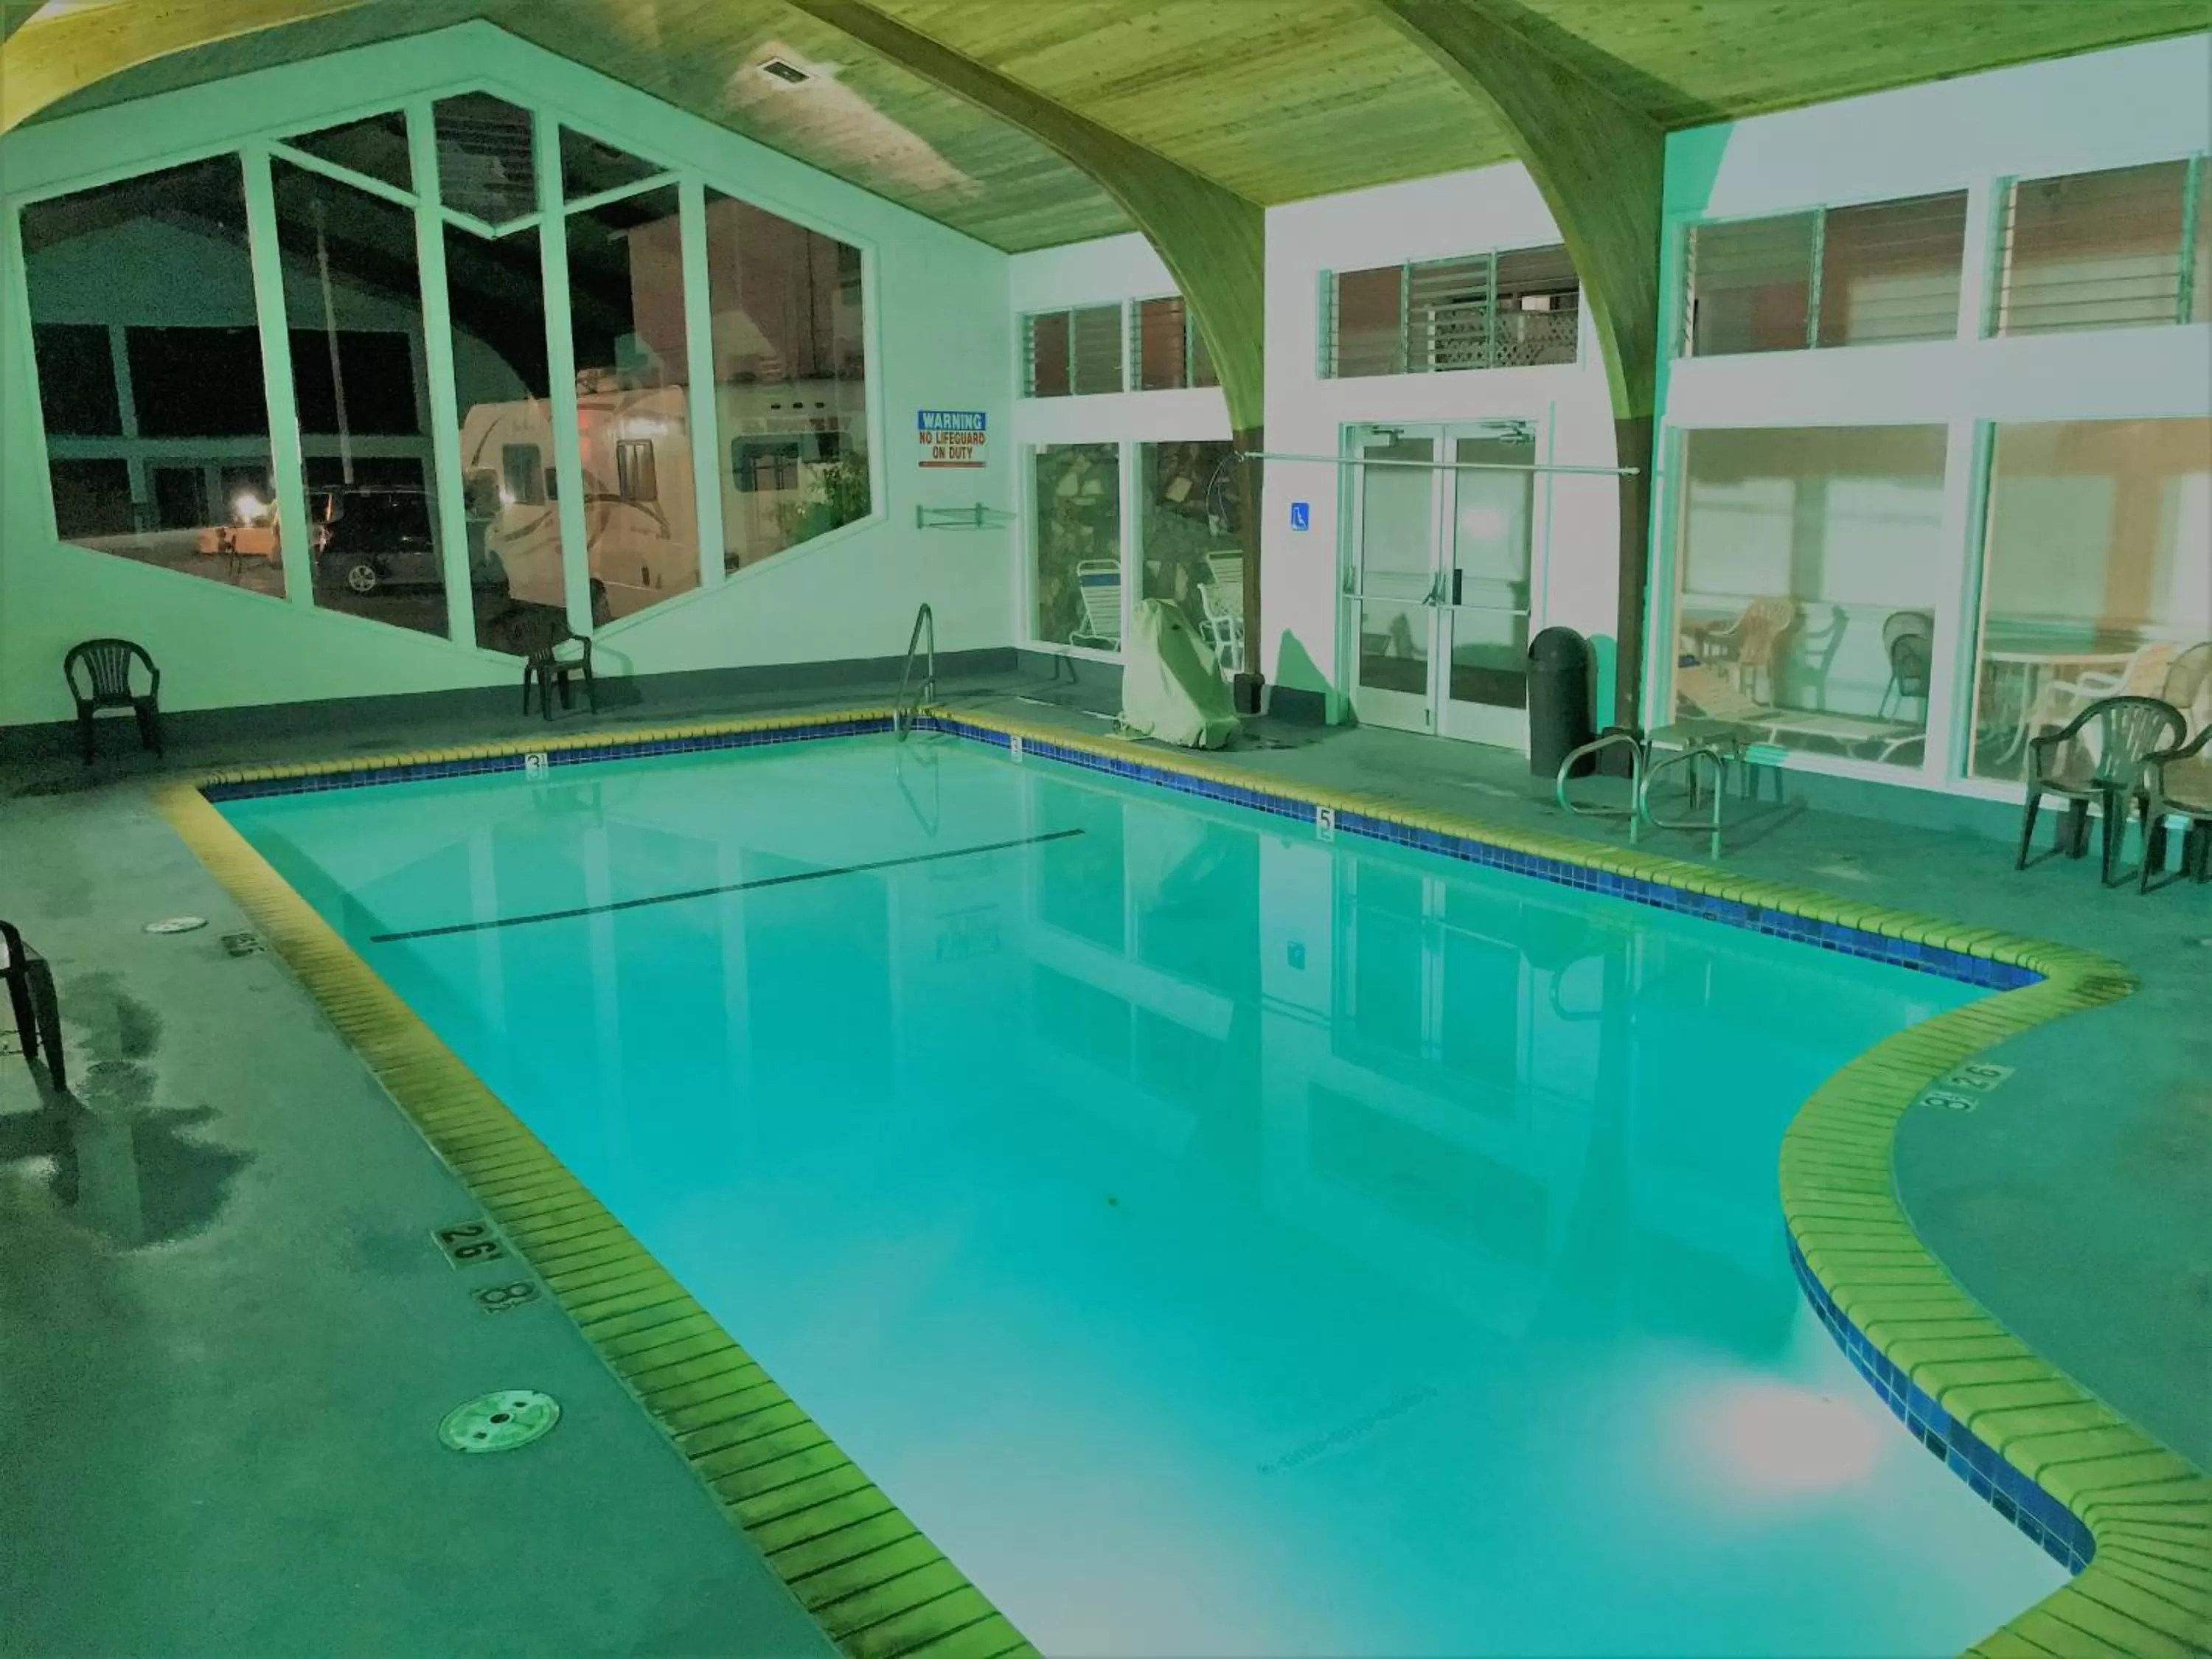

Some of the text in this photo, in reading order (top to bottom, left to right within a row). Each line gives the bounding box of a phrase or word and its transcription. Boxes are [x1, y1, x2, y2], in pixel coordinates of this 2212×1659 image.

[922, 412, 981, 429] WARNING
[919, 431, 985, 445] NO LIFEGUARD
[932, 446, 973, 459] ON DUTY
[1320, 808, 1332, 835] 5
